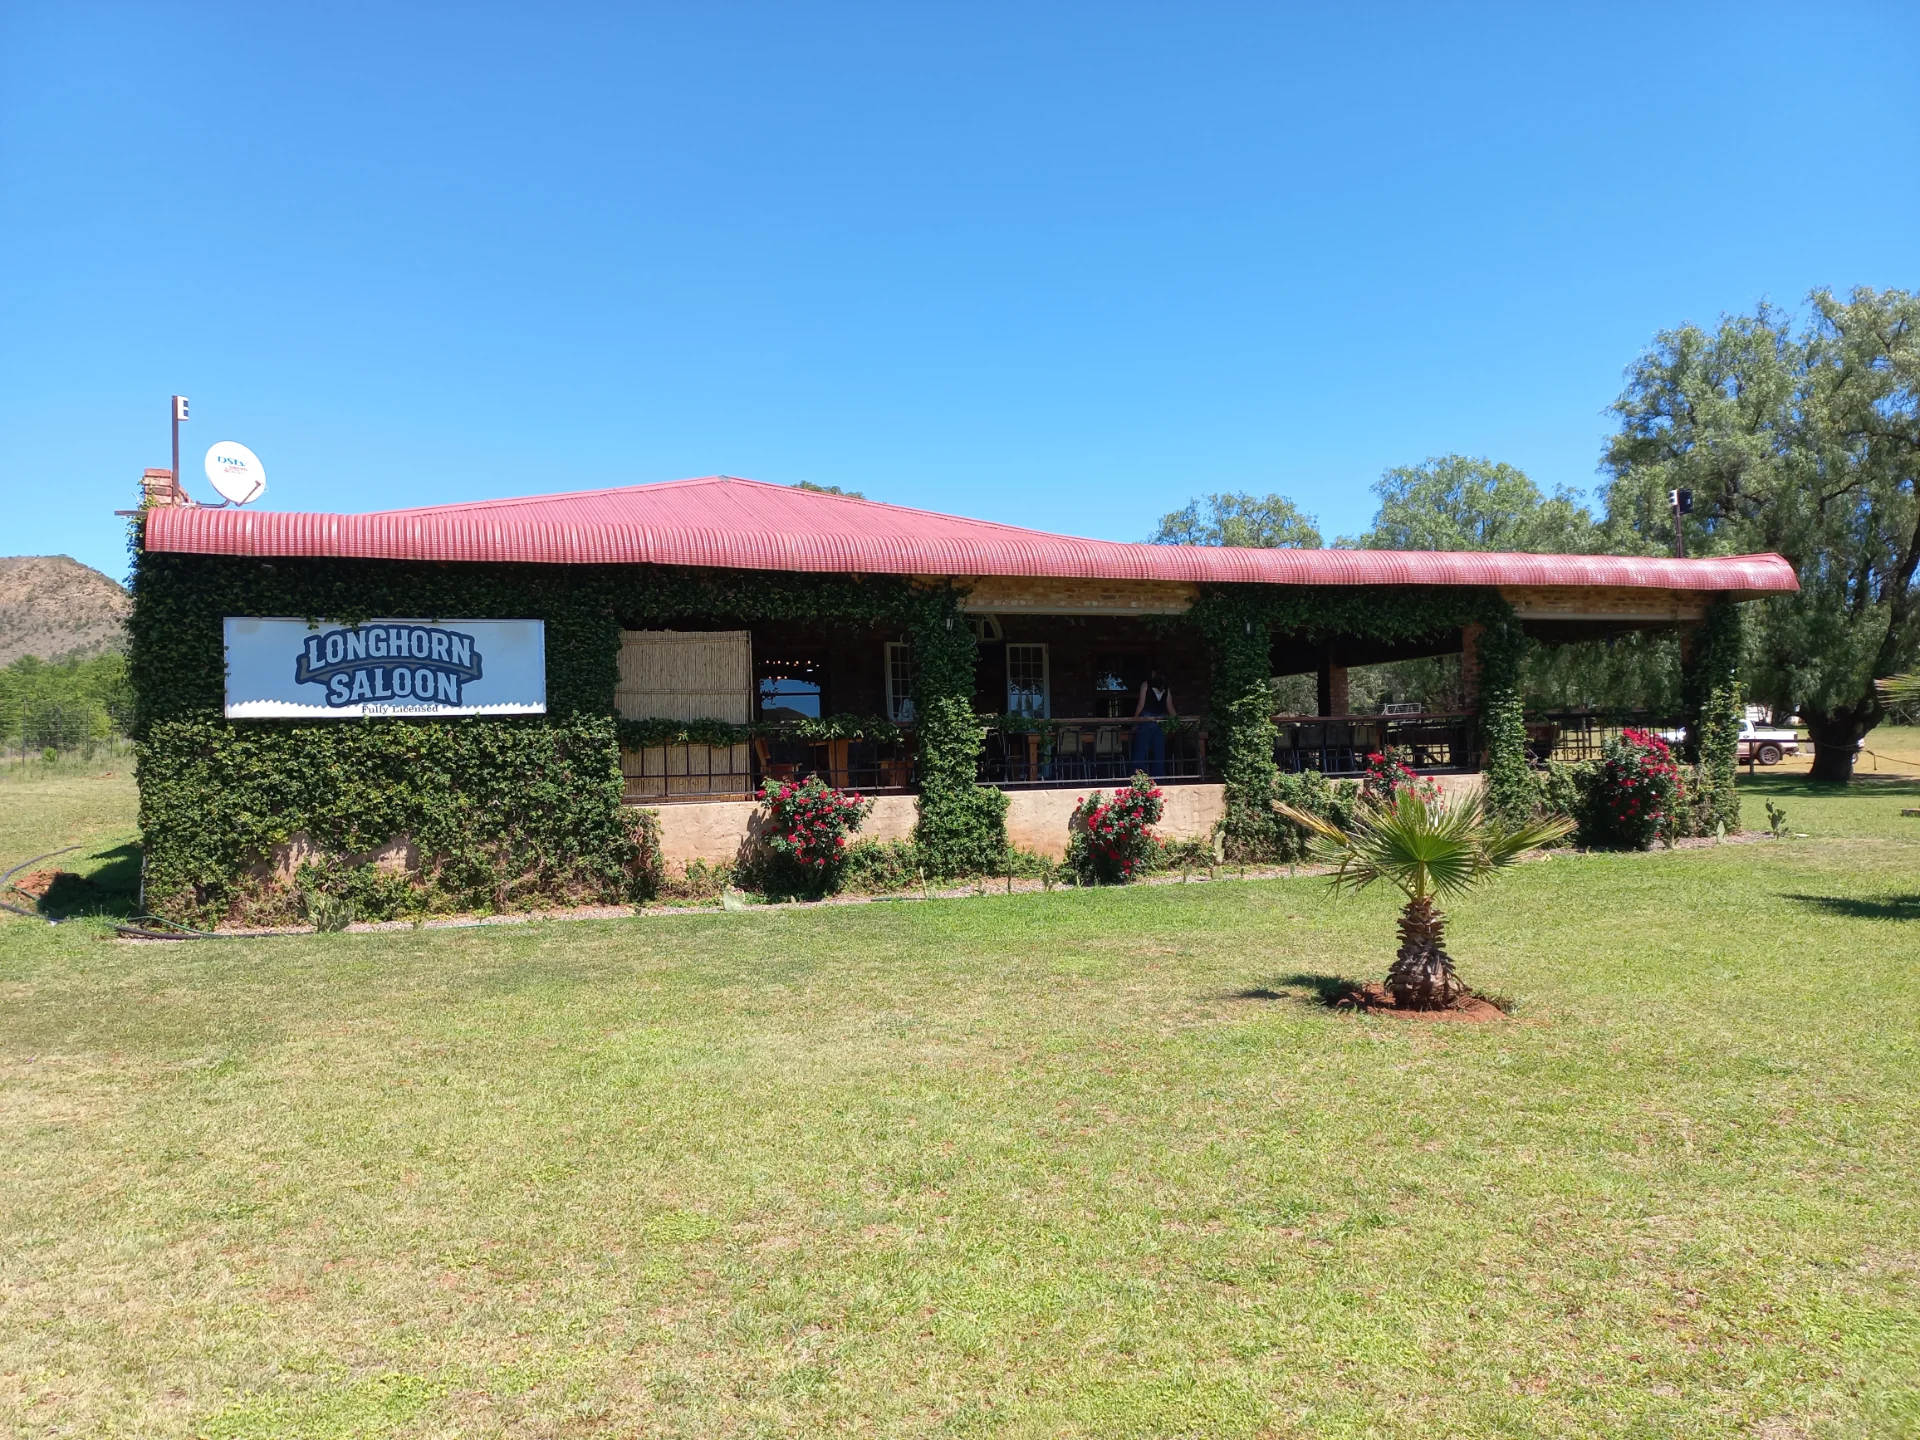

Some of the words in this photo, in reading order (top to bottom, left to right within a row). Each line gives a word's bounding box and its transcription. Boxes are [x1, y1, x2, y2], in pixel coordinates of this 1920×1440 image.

[308, 627, 472, 671] LONGHORN
[329, 667, 459, 704] SALOON
[361, 705, 388, 714] Fully
[392, 704, 439, 713] Licensed
